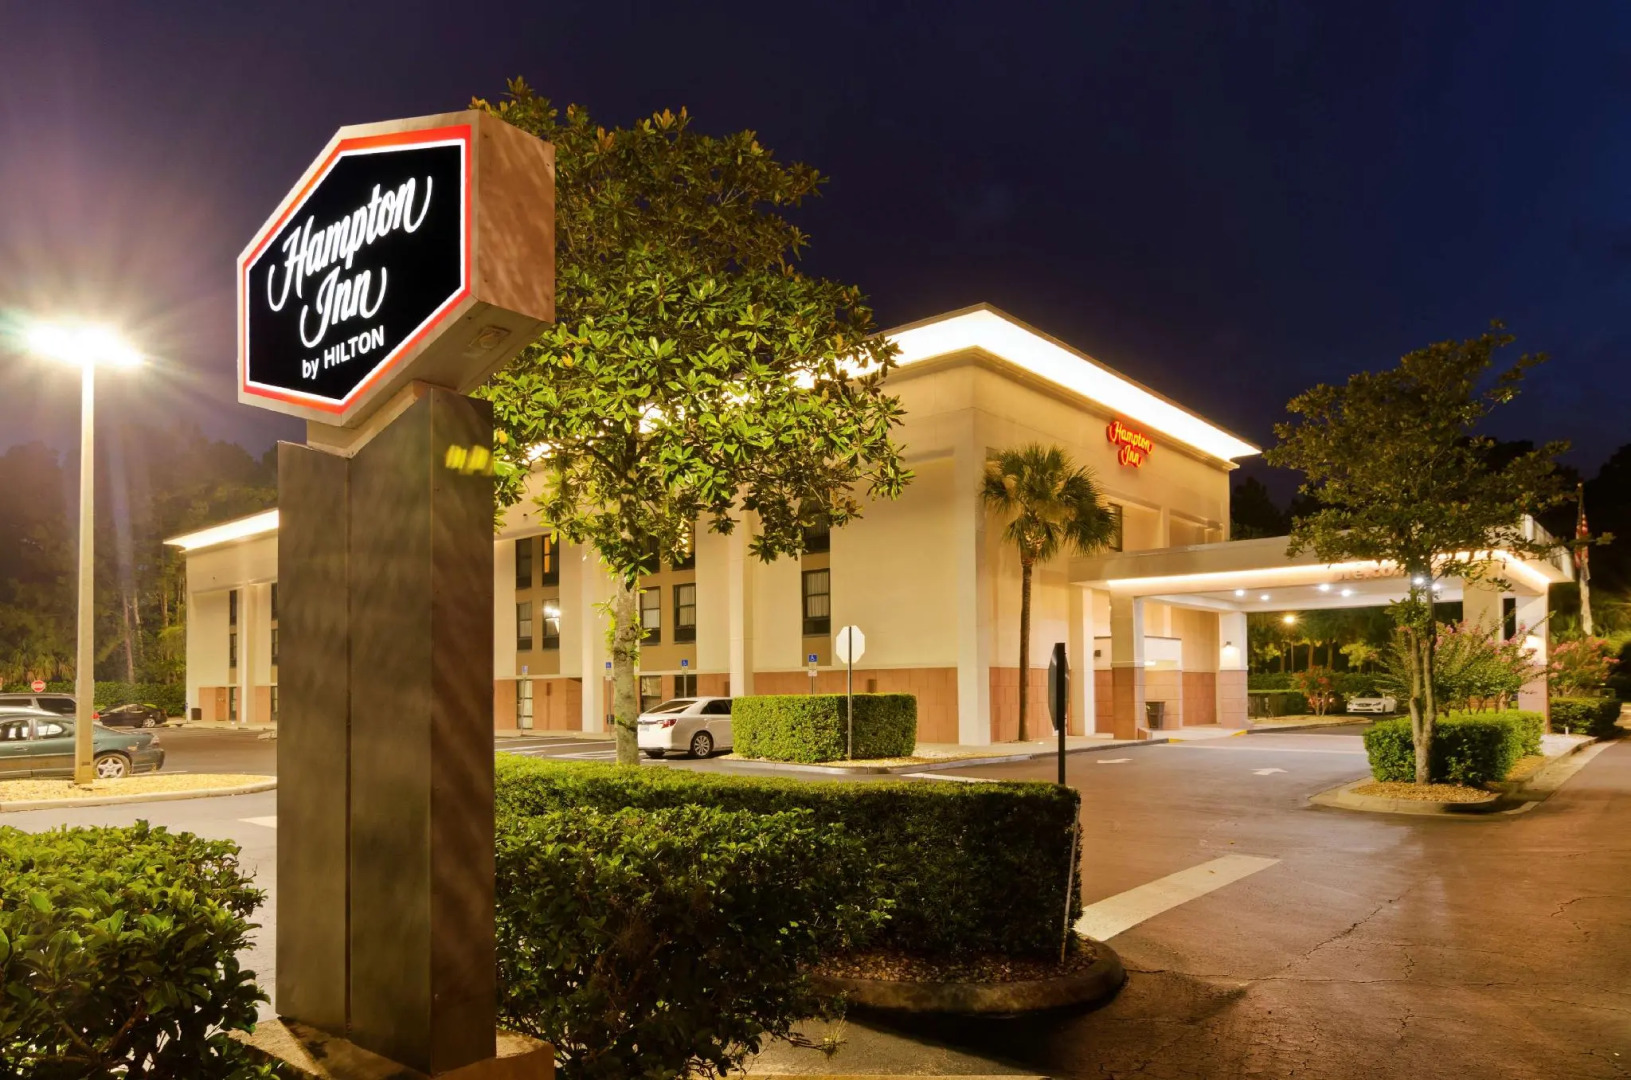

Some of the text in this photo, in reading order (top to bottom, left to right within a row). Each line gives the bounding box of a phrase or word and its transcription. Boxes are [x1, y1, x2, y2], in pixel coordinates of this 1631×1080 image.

[268, 176, 433, 312] Hampton
[300, 266, 387, 348] Inn
[302, 325, 385, 380] by HILTON
[1108, 420, 1153, 454] Hampton
[1120, 444, 1143, 467] Inn
